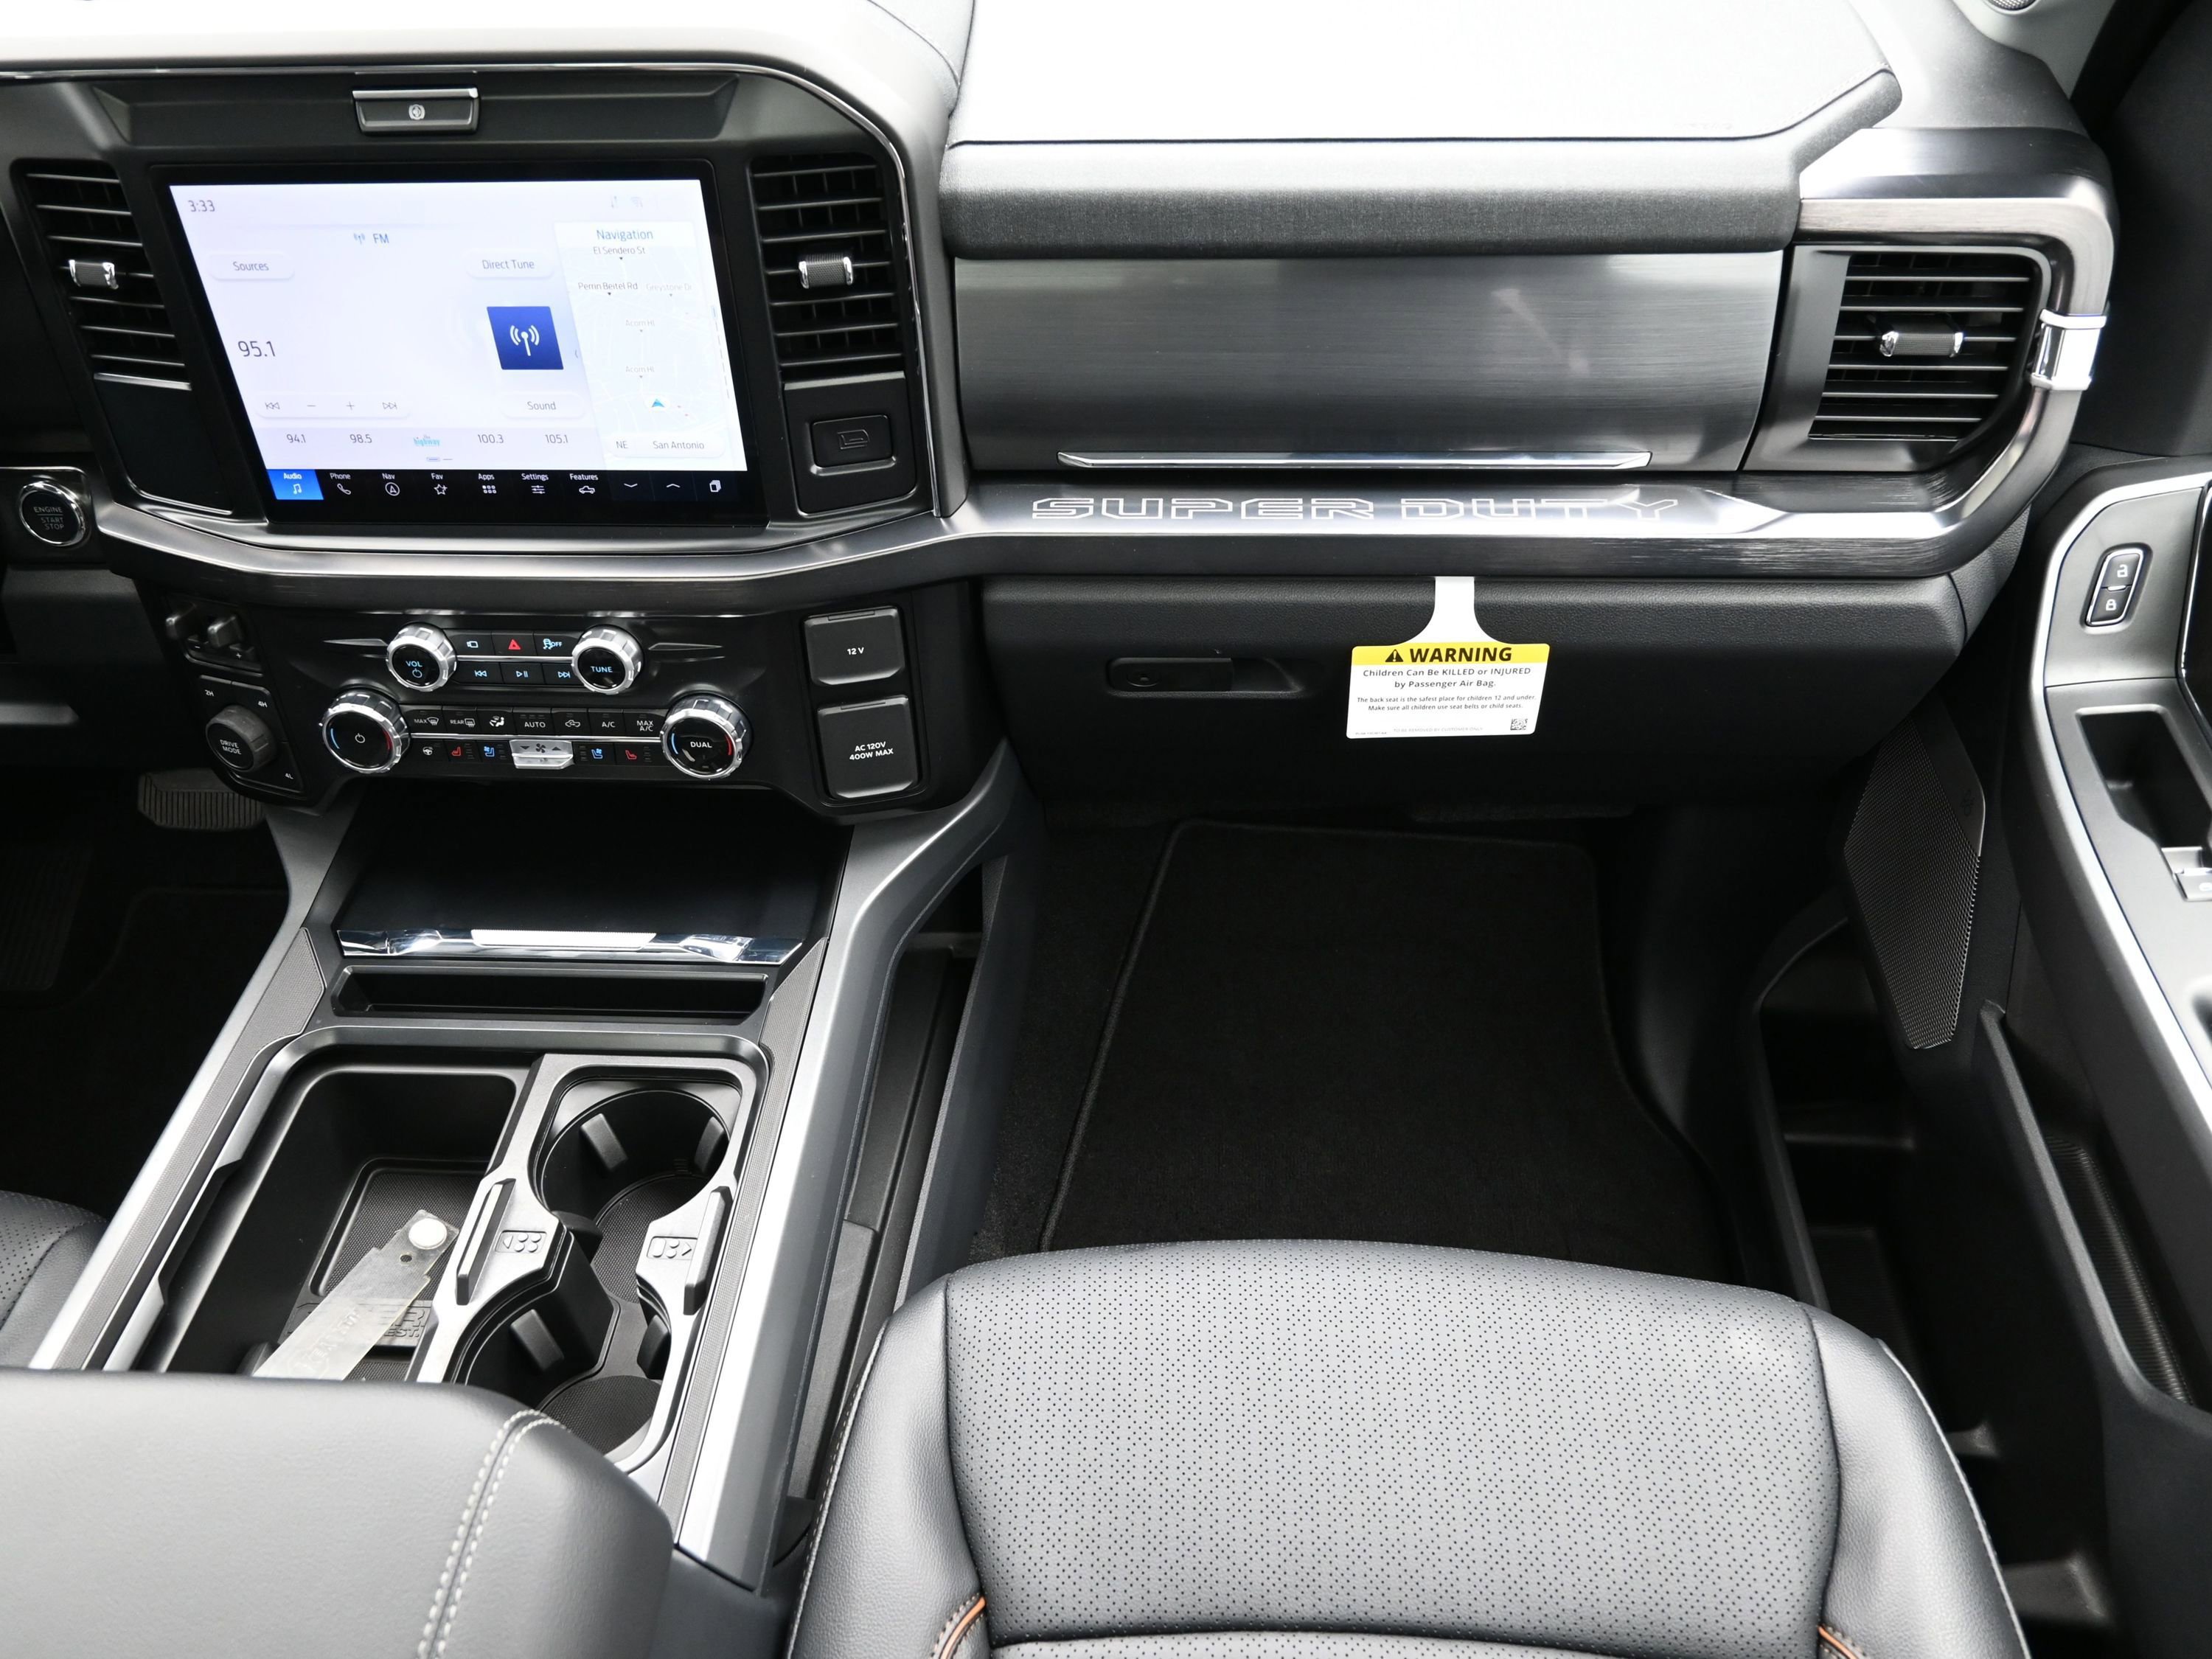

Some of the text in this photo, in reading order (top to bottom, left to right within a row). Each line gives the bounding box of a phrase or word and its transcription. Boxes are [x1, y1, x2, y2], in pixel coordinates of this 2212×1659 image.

[188, 200, 215, 212] 3:33
[373, 233, 389, 244] FM
[597, 229, 653, 242] Navigation
[602, 246, 636, 254] Sendero
[232, 261, 269, 271] Sources
[482, 260, 535, 270] Direct Tune
[627, 282, 638, 290] Rd
[237, 341, 276, 357] 95.1
[527, 400, 557, 411] Sound
[286, 434, 306, 444] 94.1
[349, 434, 372, 444] 98.5
[477, 434, 504, 444] 100.3
[545, 434, 568, 444] 105.1
[616, 441, 705, 449] NE San Antonio
[478, 473, 495, 481] Apps
[521, 473, 549, 481] Settings
[1033, 497, 1679, 520] SUPER DUTY
[1409, 647, 1512, 663] WARNING
[1363, 669, 1404, 677] Children
[1490, 667, 1531, 675] INJURED
[1394, 681, 1406, 689] by
[1408, 681, 1457, 689] Passenger
[1476, 680, 1497, 688] Bag.
[220, 740, 239, 748] DRIVE
[867, 741, 886, 751] 120V
[222, 745, 242, 755] MODE
[849, 748, 894, 760] 400W MAX
[383, 1328, 420, 1338] EST.
